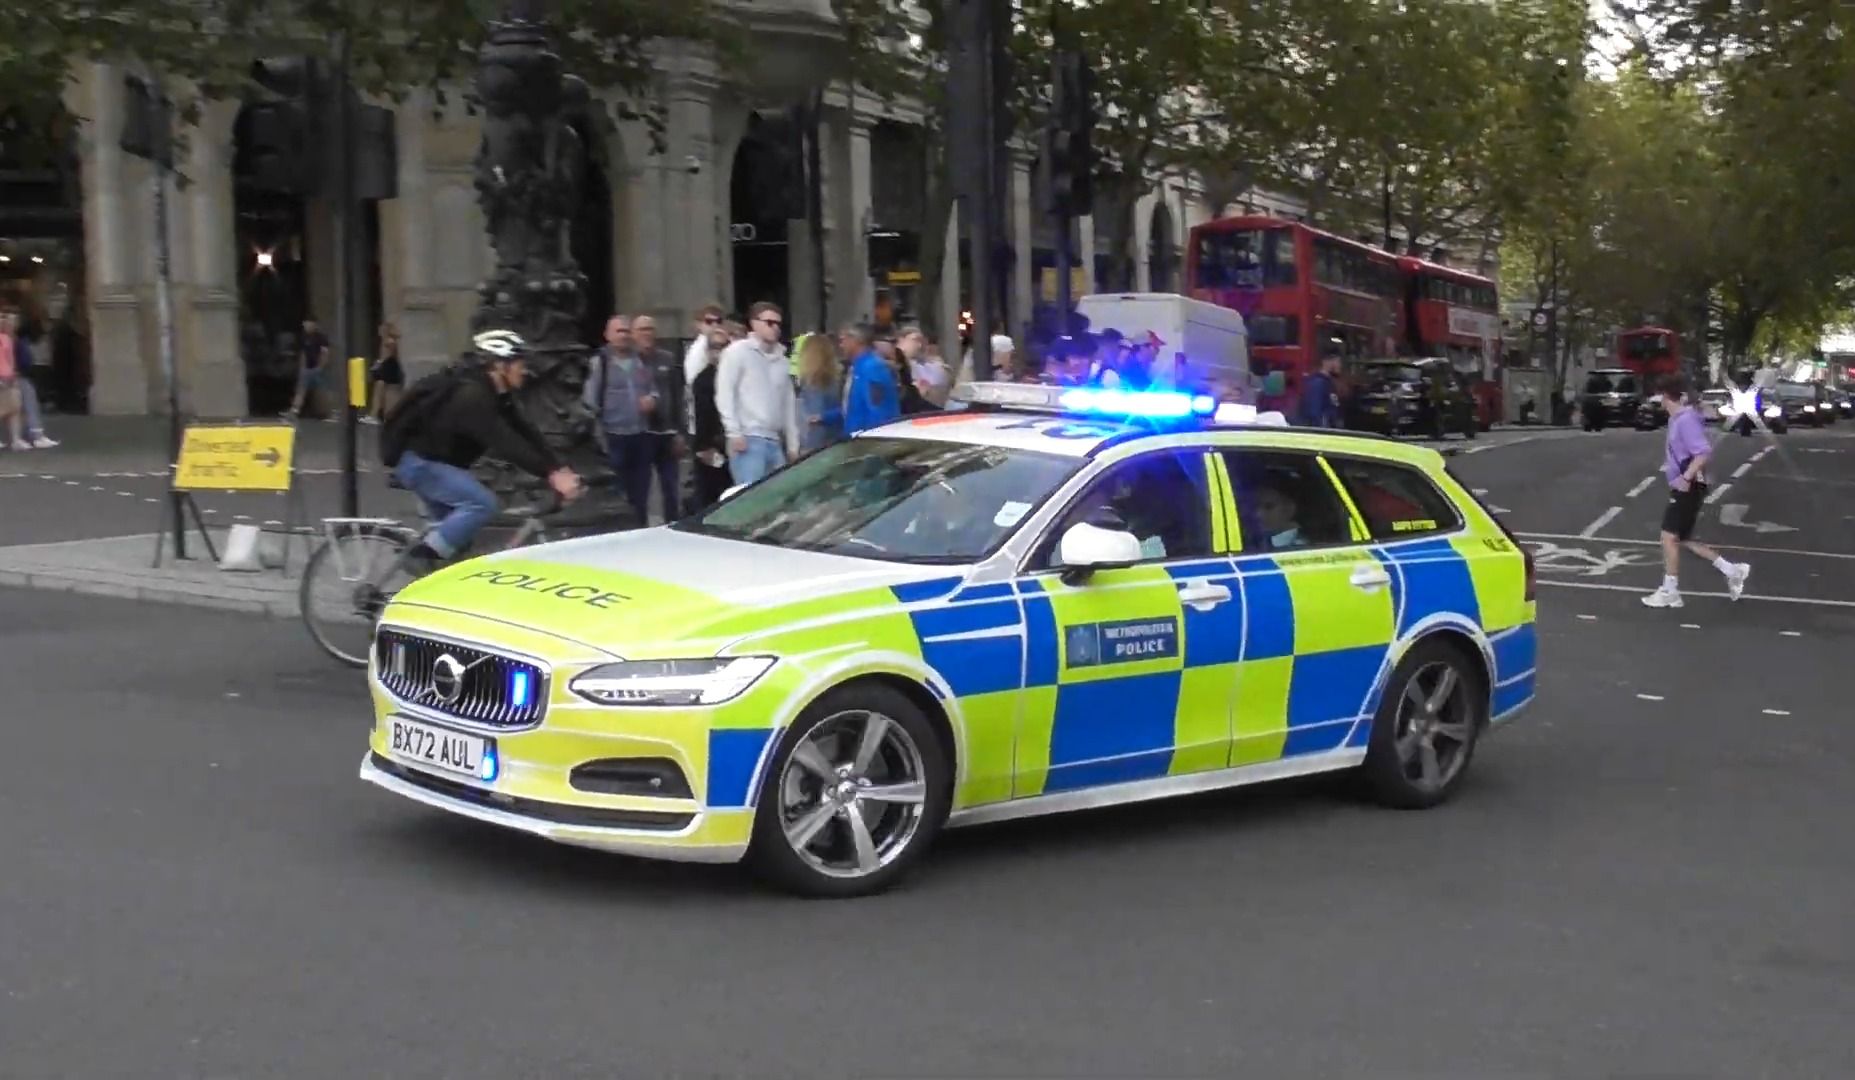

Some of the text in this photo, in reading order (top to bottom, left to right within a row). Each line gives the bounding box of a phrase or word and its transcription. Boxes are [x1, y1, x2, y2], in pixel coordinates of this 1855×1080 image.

[459, 570, 632, 609] POLICE
[1115, 638, 1165, 656] POLICE
[392, 721, 476, 771] BX72 AUL
